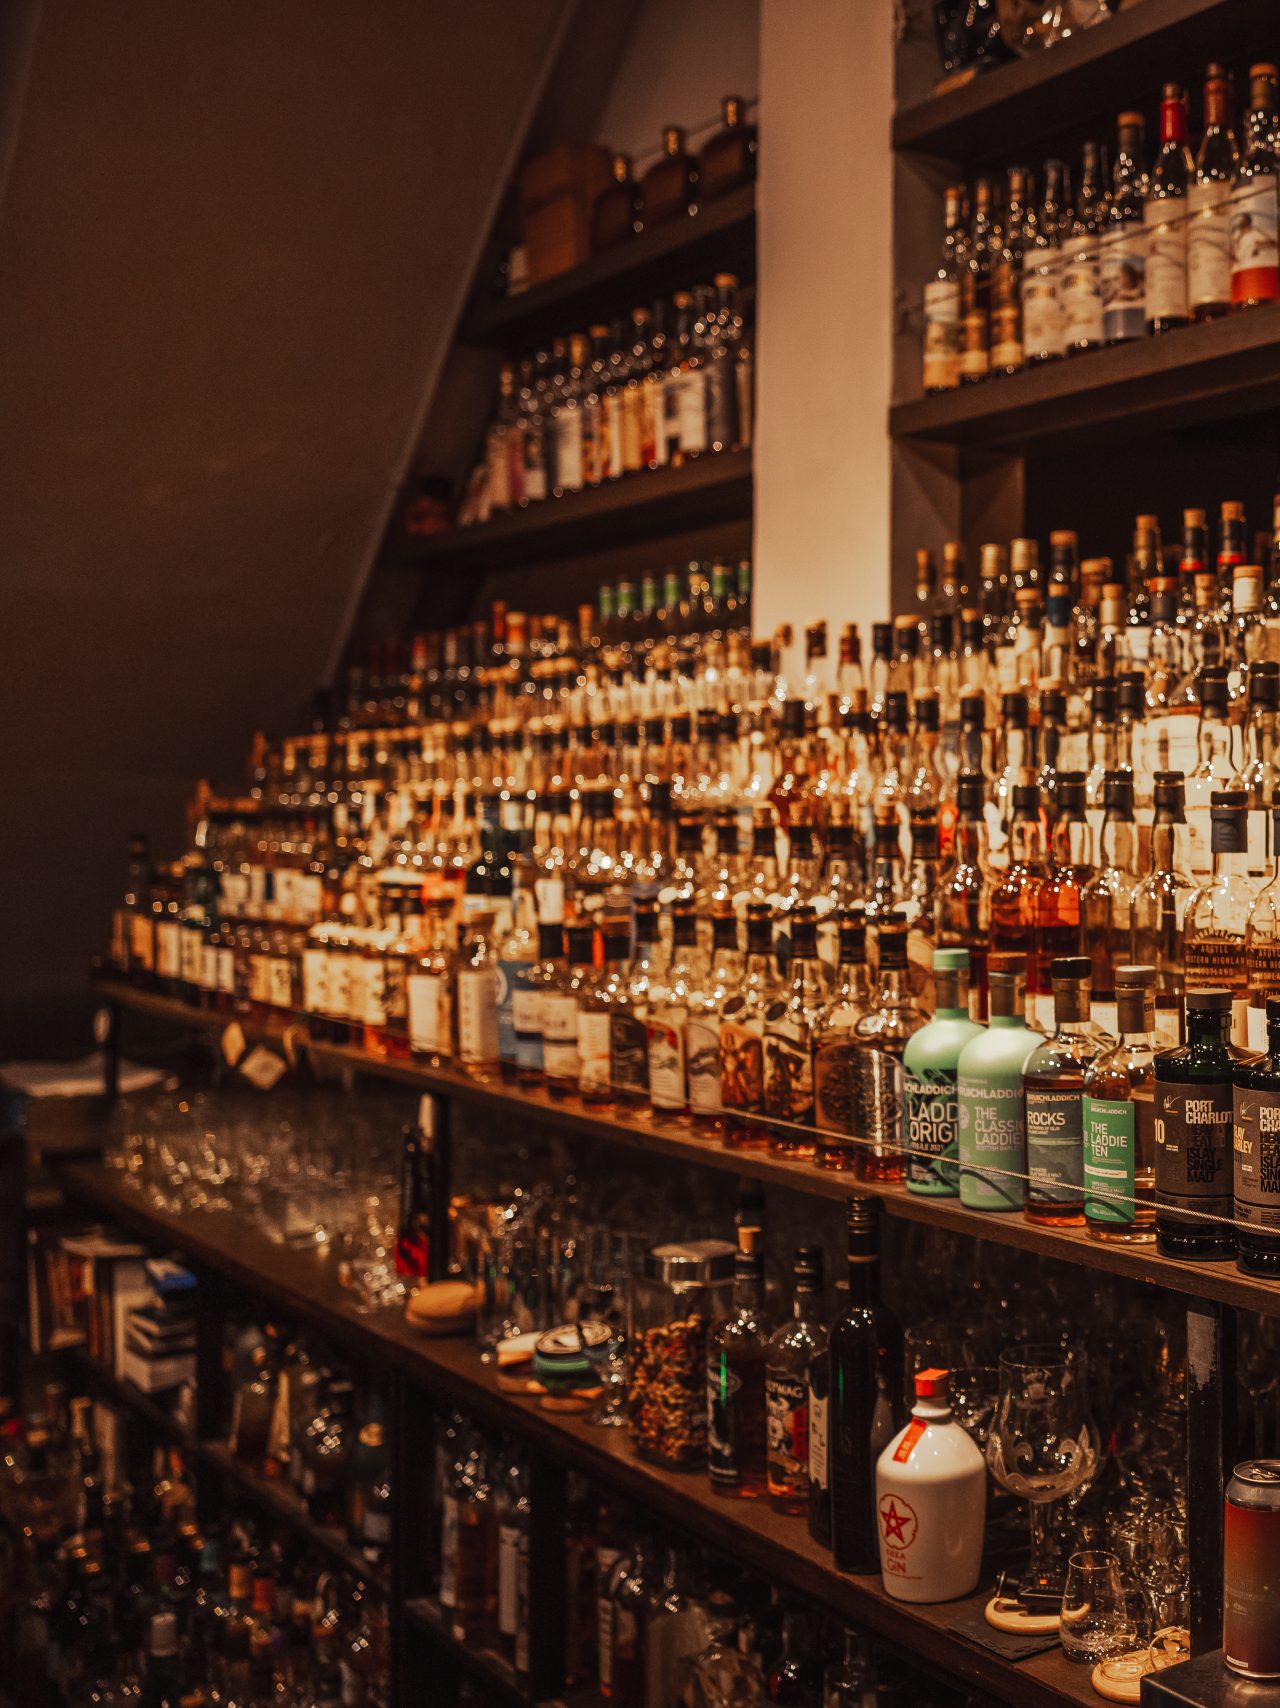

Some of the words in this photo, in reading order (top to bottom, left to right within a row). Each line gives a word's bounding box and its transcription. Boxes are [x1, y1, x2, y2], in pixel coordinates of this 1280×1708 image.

[1200, 944, 1228, 954] ARGYLL
[974, 1106, 998, 1120] THE
[1185, 1100, 1214, 1112] PORT
[1027, 1111, 1066, 1126] ROCKS
[1090, 1122, 1108, 1134] THE
[1154, 1118, 1165, 1144] 10
[976, 1132, 1020, 1146] LADDIE
[1090, 1134, 1128, 1148] LADDIE
[1091, 1144, 1108, 1158] TEN
[1187, 1170, 1215, 1182] MALT
[886, 1559, 906, 1574] GIN
